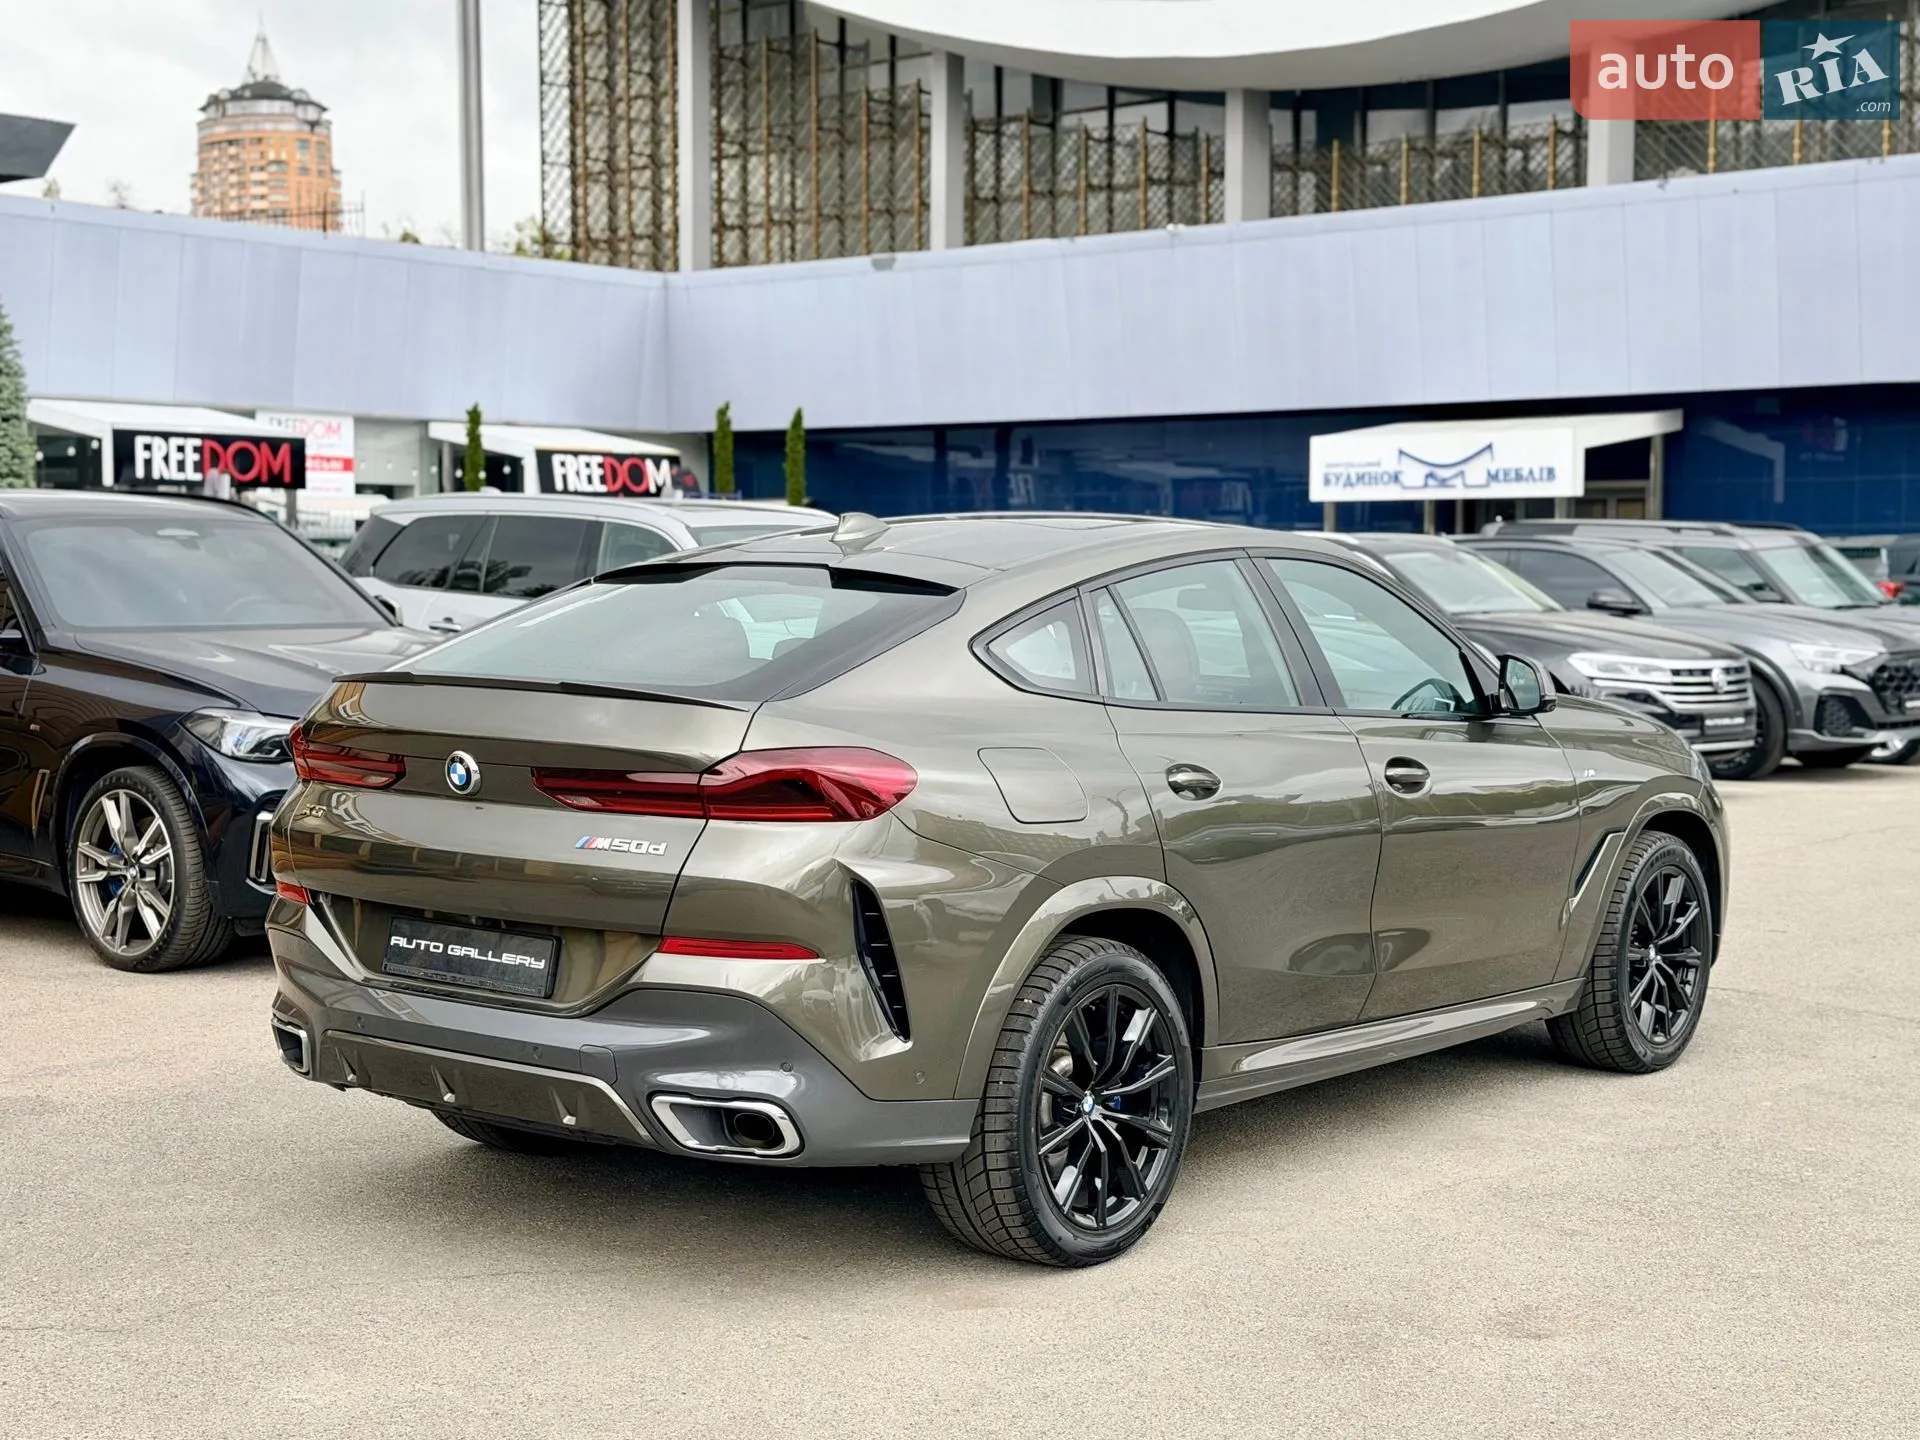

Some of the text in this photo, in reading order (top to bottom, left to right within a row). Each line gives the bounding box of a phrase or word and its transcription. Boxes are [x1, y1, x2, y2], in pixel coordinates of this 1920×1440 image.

[134, 434, 291, 484] FREEDOM
[551, 453, 672, 494] FREEDOM
[391, 936, 545, 969] AUTO GALLERY
